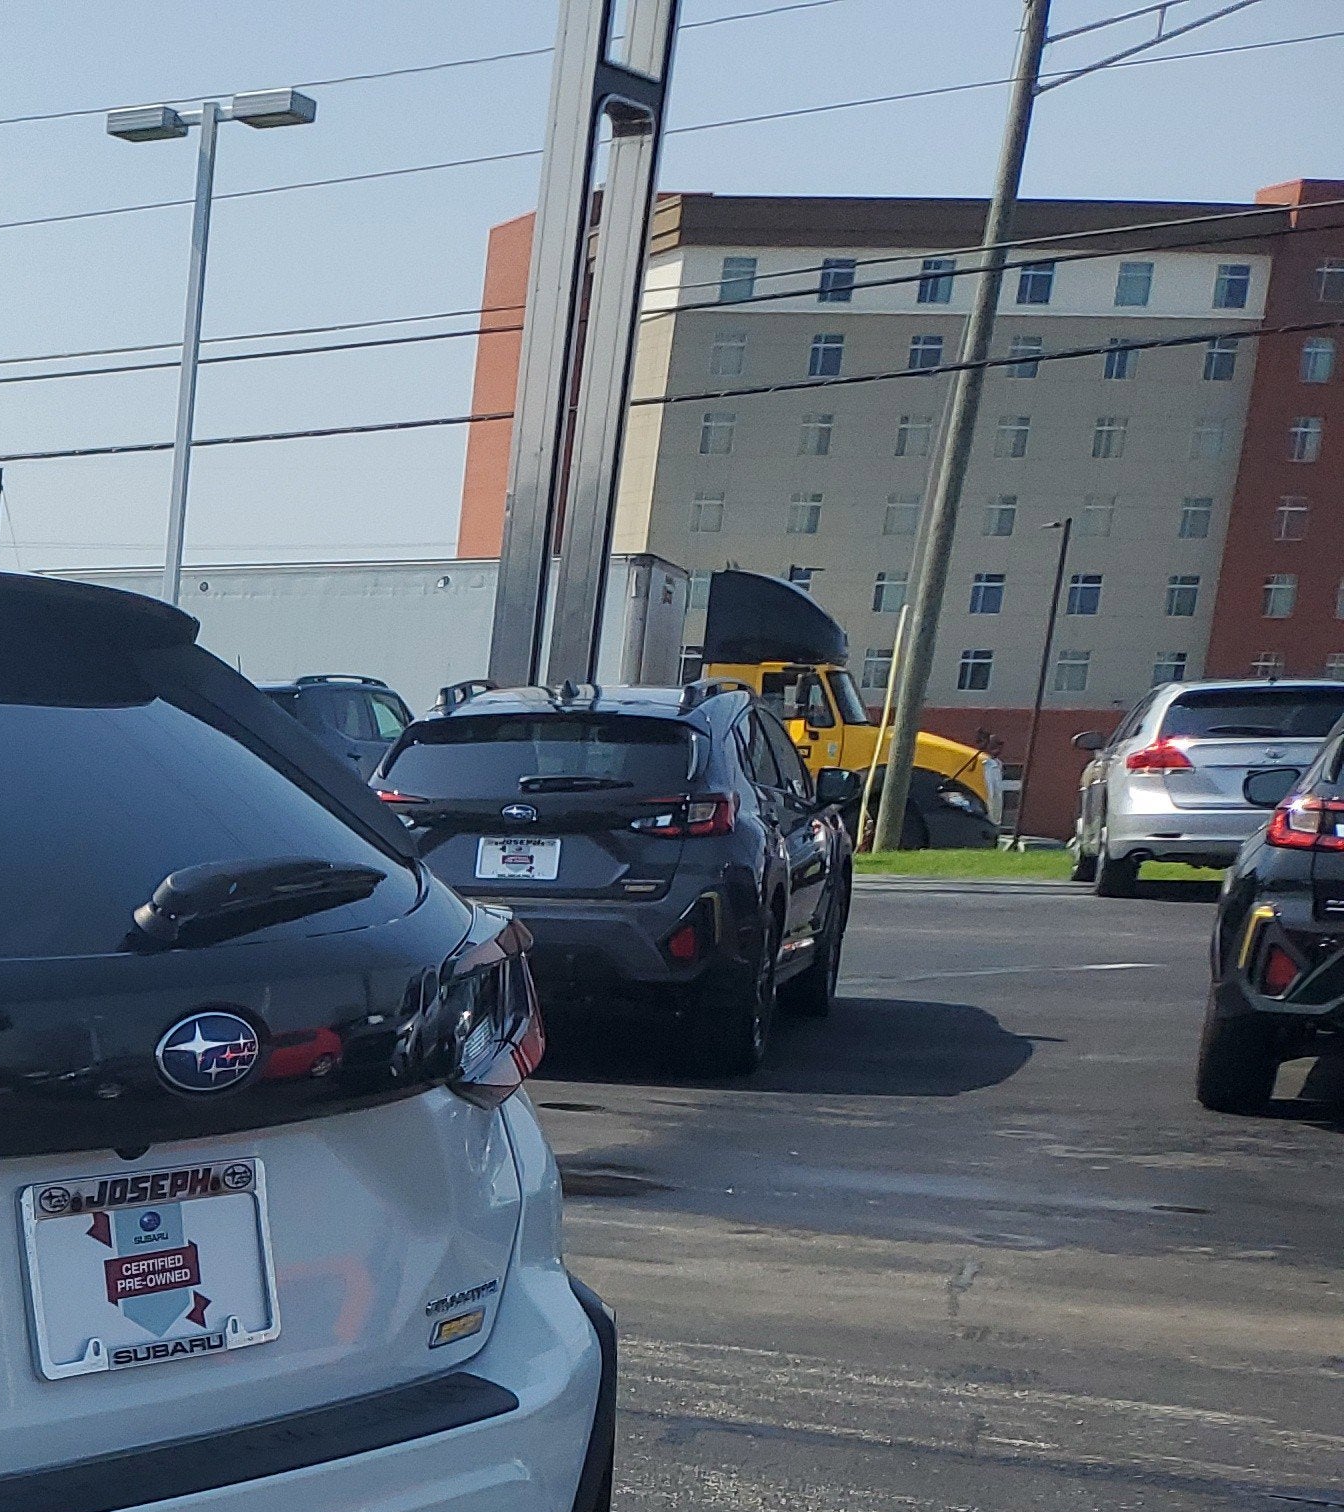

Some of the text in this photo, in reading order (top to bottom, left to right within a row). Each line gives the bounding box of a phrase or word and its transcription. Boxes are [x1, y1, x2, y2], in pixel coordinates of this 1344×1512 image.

[84, 1167, 213, 1208] JOSEPH
[133, 1232, 169, 1245] SUBARU
[121, 1254, 184, 1276] CERTIFIED
[116, 1267, 191, 1292] PRE-OWNED
[113, 1334, 224, 1365] SUBARU
